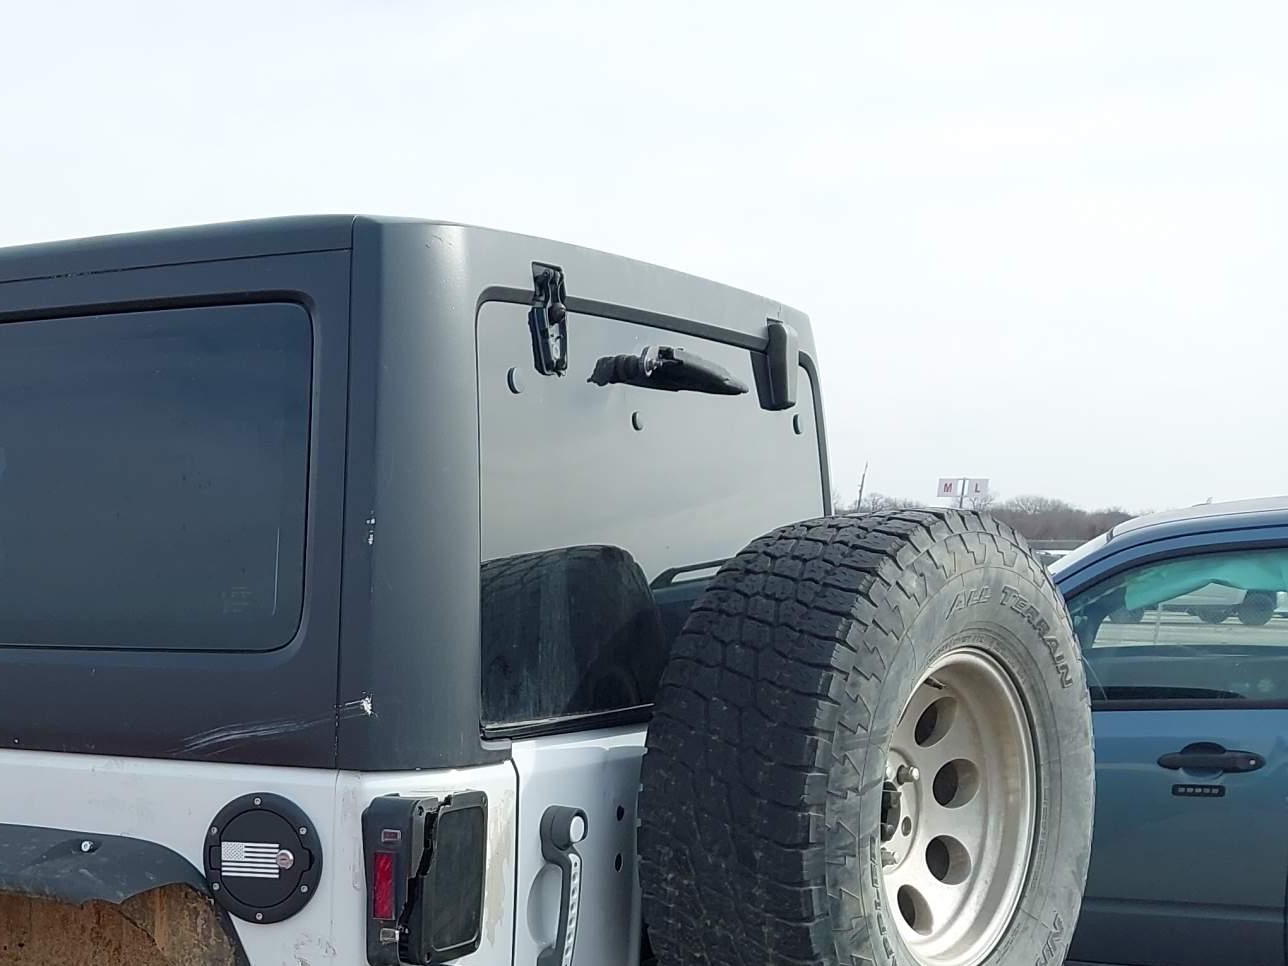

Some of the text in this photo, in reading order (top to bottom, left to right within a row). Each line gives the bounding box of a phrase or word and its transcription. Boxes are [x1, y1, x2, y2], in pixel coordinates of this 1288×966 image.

[943, 483, 953, 493] M
[974, 482, 981, 493] L
[945, 586, 992, 620] ALL
[999, 584, 1073, 689] TERRAIN
